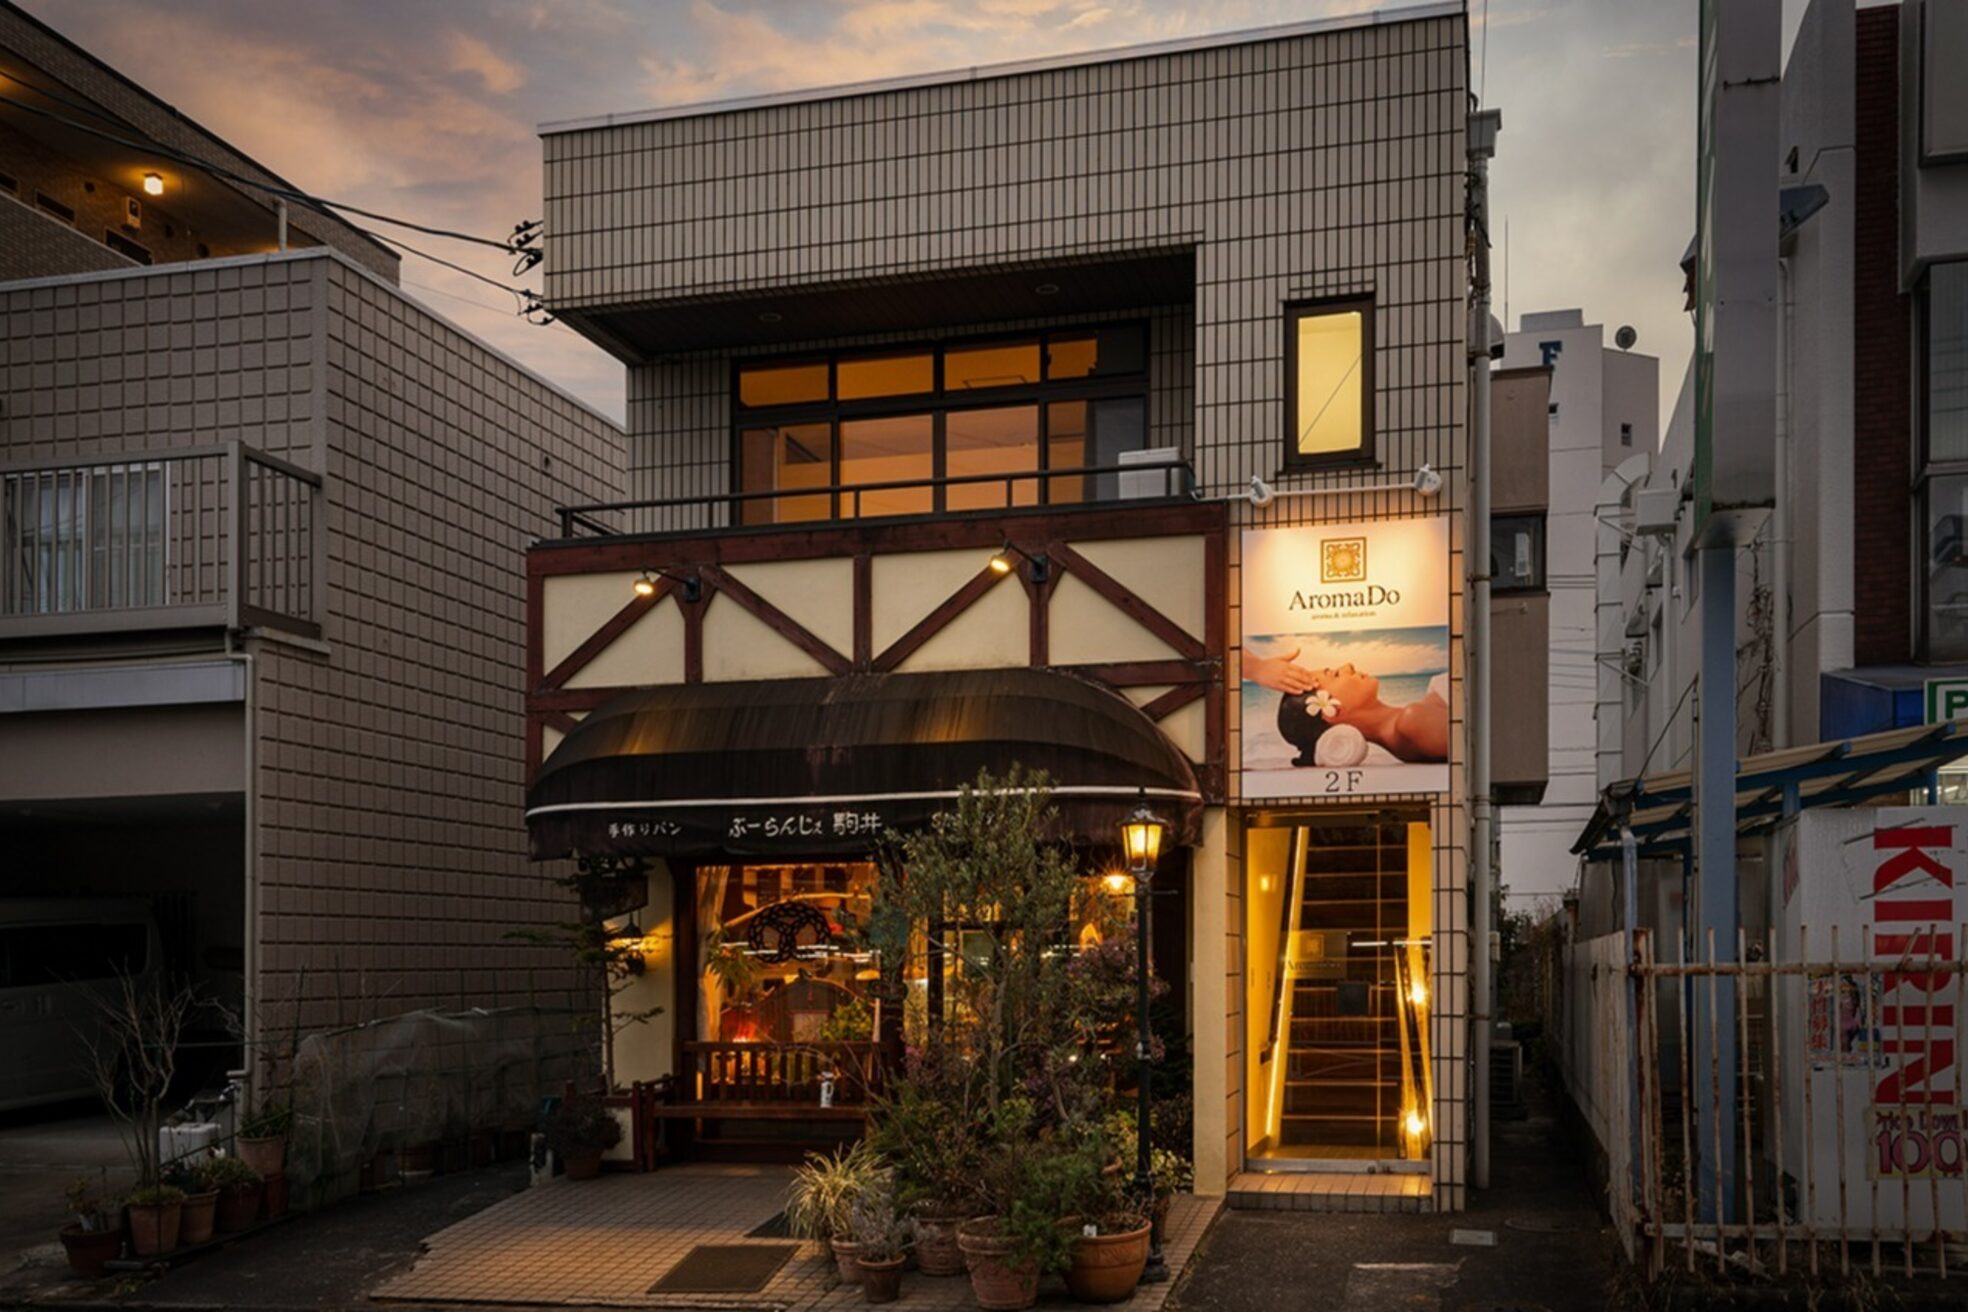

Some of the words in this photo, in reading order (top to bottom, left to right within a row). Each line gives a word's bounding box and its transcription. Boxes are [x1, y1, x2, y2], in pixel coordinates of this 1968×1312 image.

[1288, 584, 1401, 611] AromaDo
[1945, 690, 1968, 719] P
[607, 820, 683, 839] 手作りパン
[832, 811, 884, 837] 駒井
[1873, 825, 1954, 1104] KIRIN
